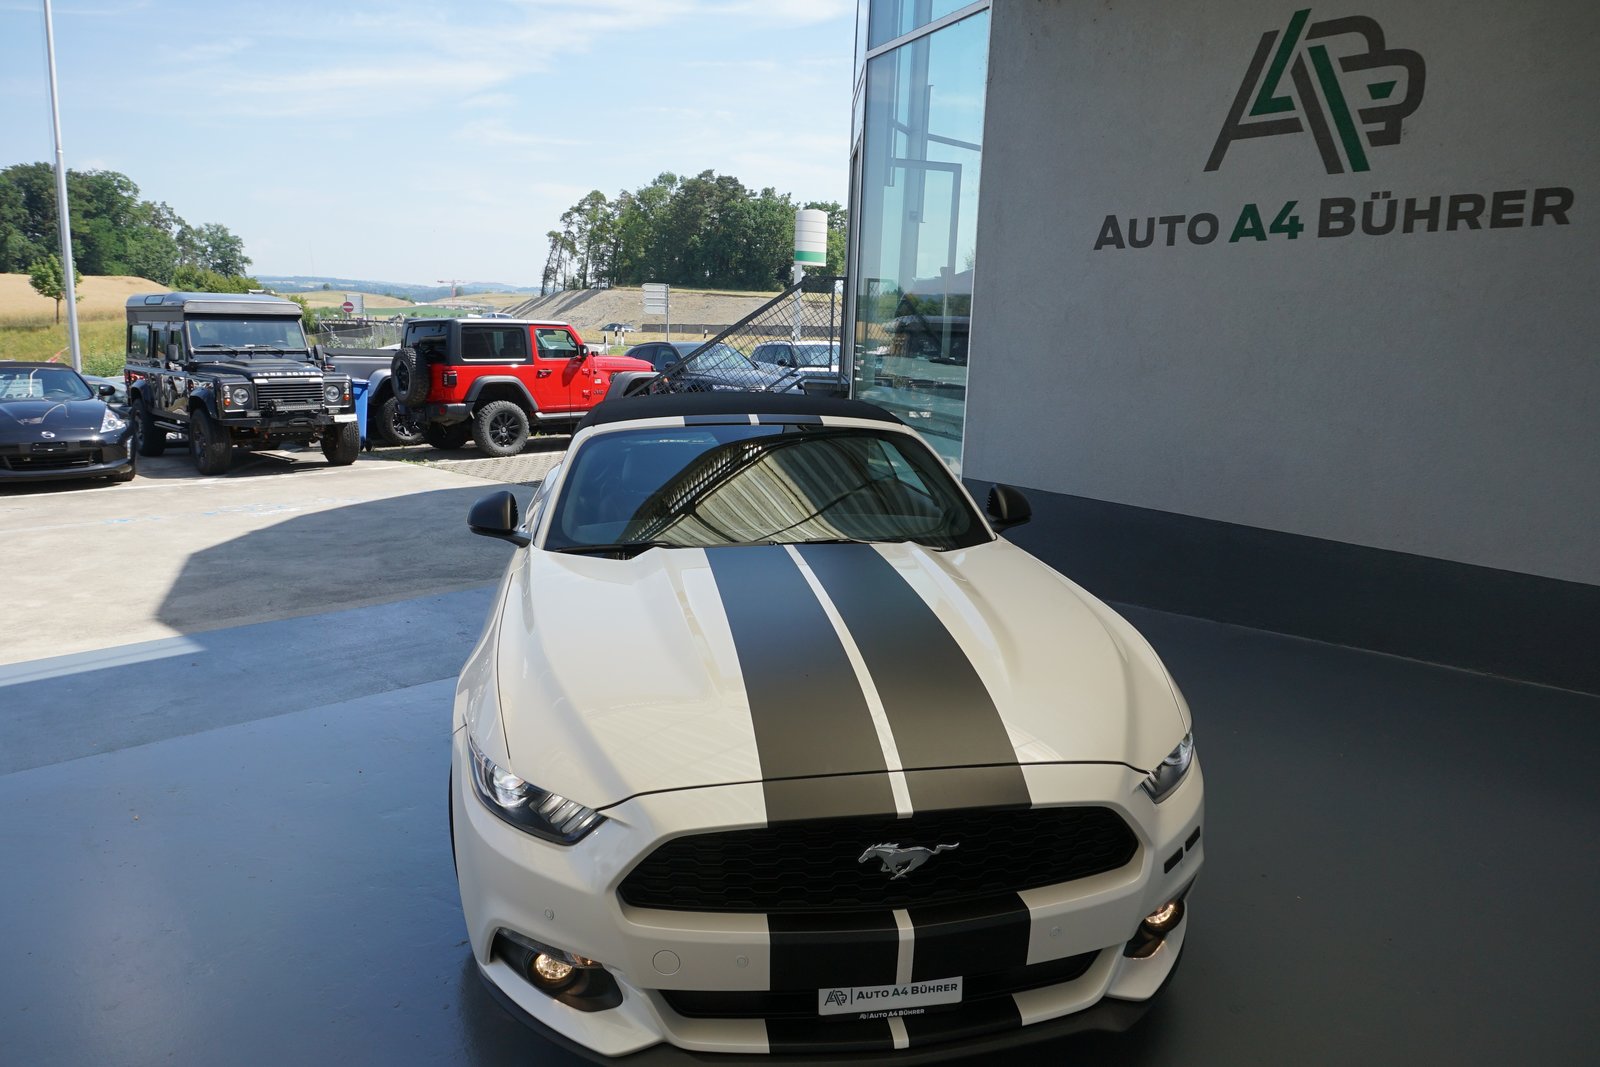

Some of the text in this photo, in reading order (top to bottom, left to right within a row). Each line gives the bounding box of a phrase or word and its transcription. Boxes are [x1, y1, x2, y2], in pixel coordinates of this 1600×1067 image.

[1093, 186, 1574, 250] AUTO A4 BÜHRER
[856, 990, 889, 1000] AUTO
[892, 987, 909, 997] A4
[911, 983, 958, 995] BÜHRER
